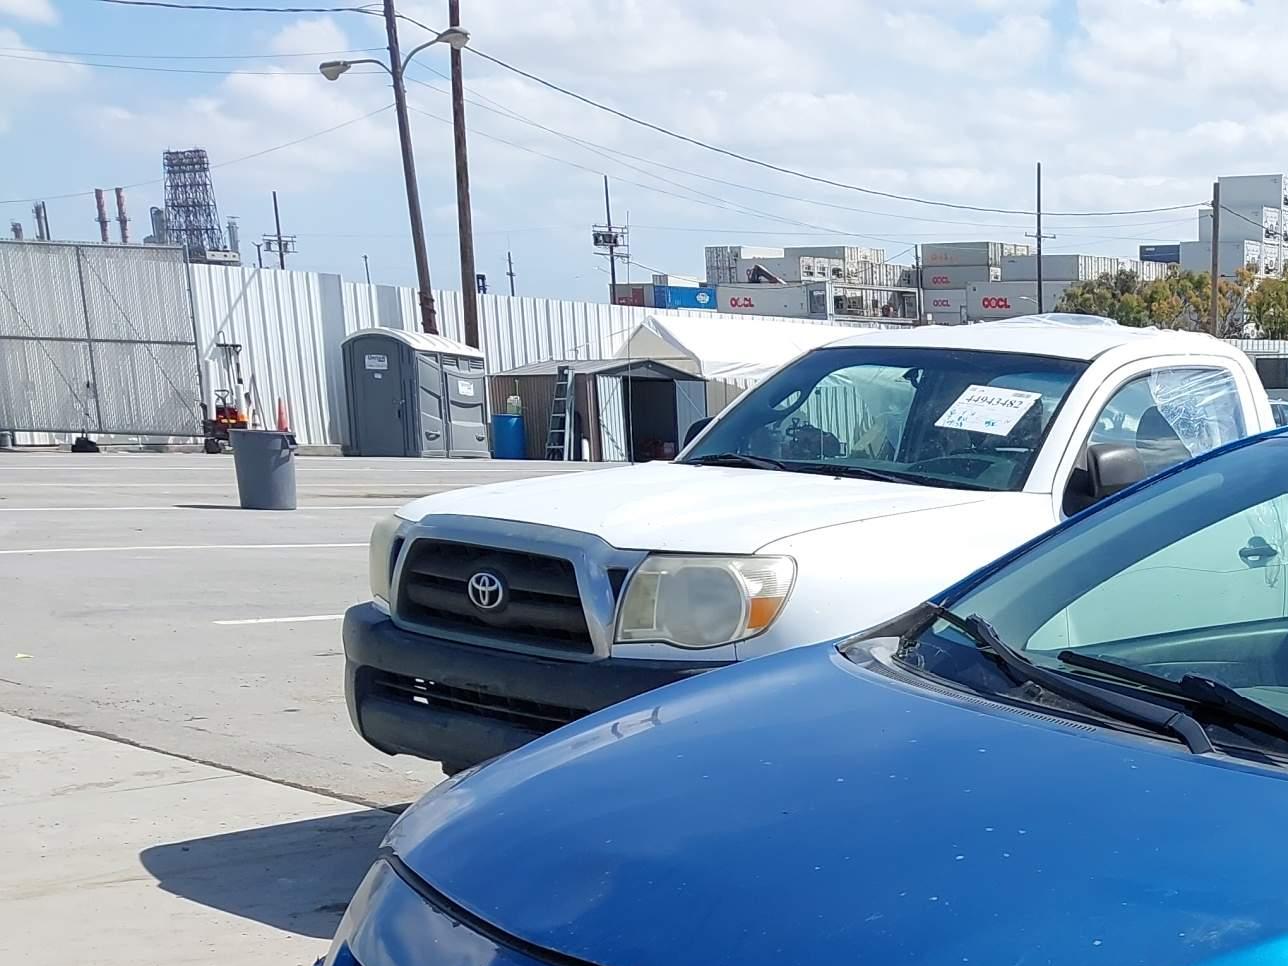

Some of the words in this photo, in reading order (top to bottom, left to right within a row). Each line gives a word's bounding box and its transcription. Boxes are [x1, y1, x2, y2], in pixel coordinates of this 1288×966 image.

[932, 276, 950, 285] OOCL
[932, 299, 951, 308] OOCL
[982, 297, 1011, 309] OOCL
[965, 394, 1024, 409] 44943482
